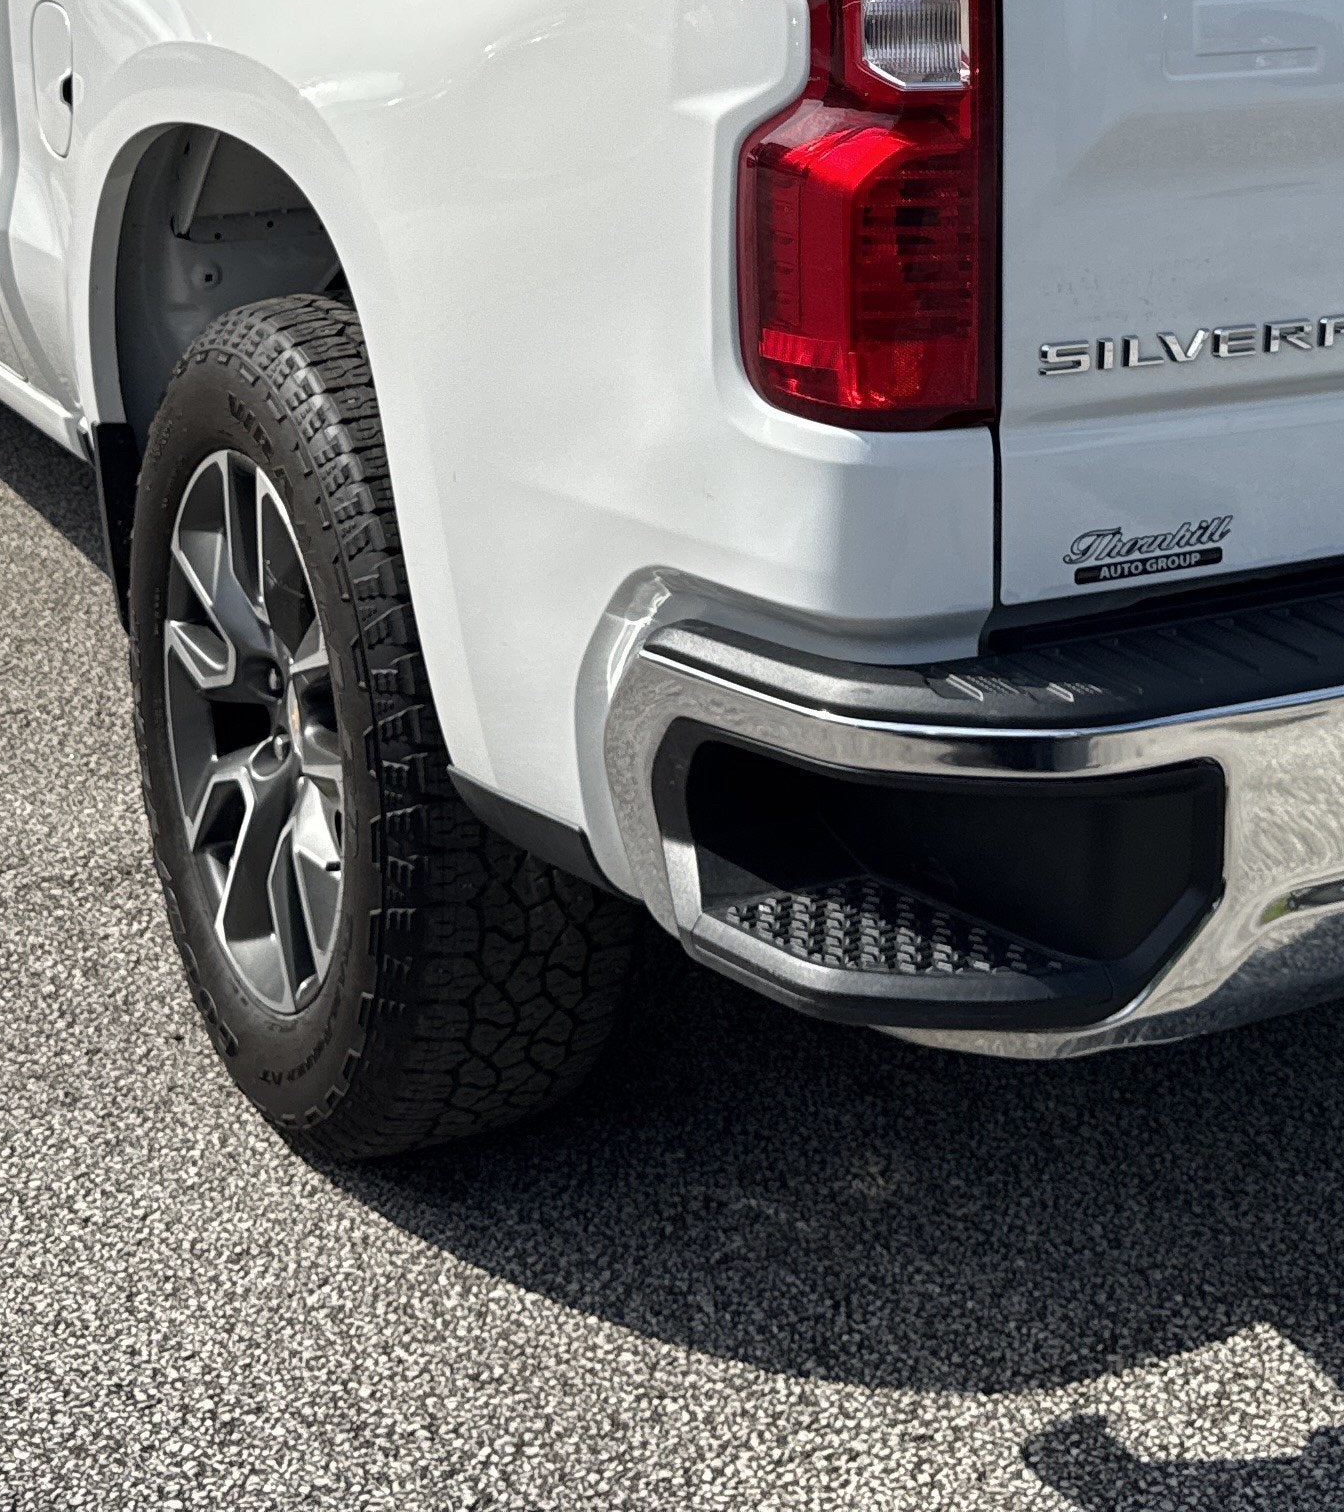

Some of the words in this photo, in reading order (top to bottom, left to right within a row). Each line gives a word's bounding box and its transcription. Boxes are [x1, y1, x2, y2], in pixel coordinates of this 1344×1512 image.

[1062, 514, 1234, 565] Thornhill
[1099, 561, 1143, 579] AUTO
[1145, 552, 1202, 571] GROUP
